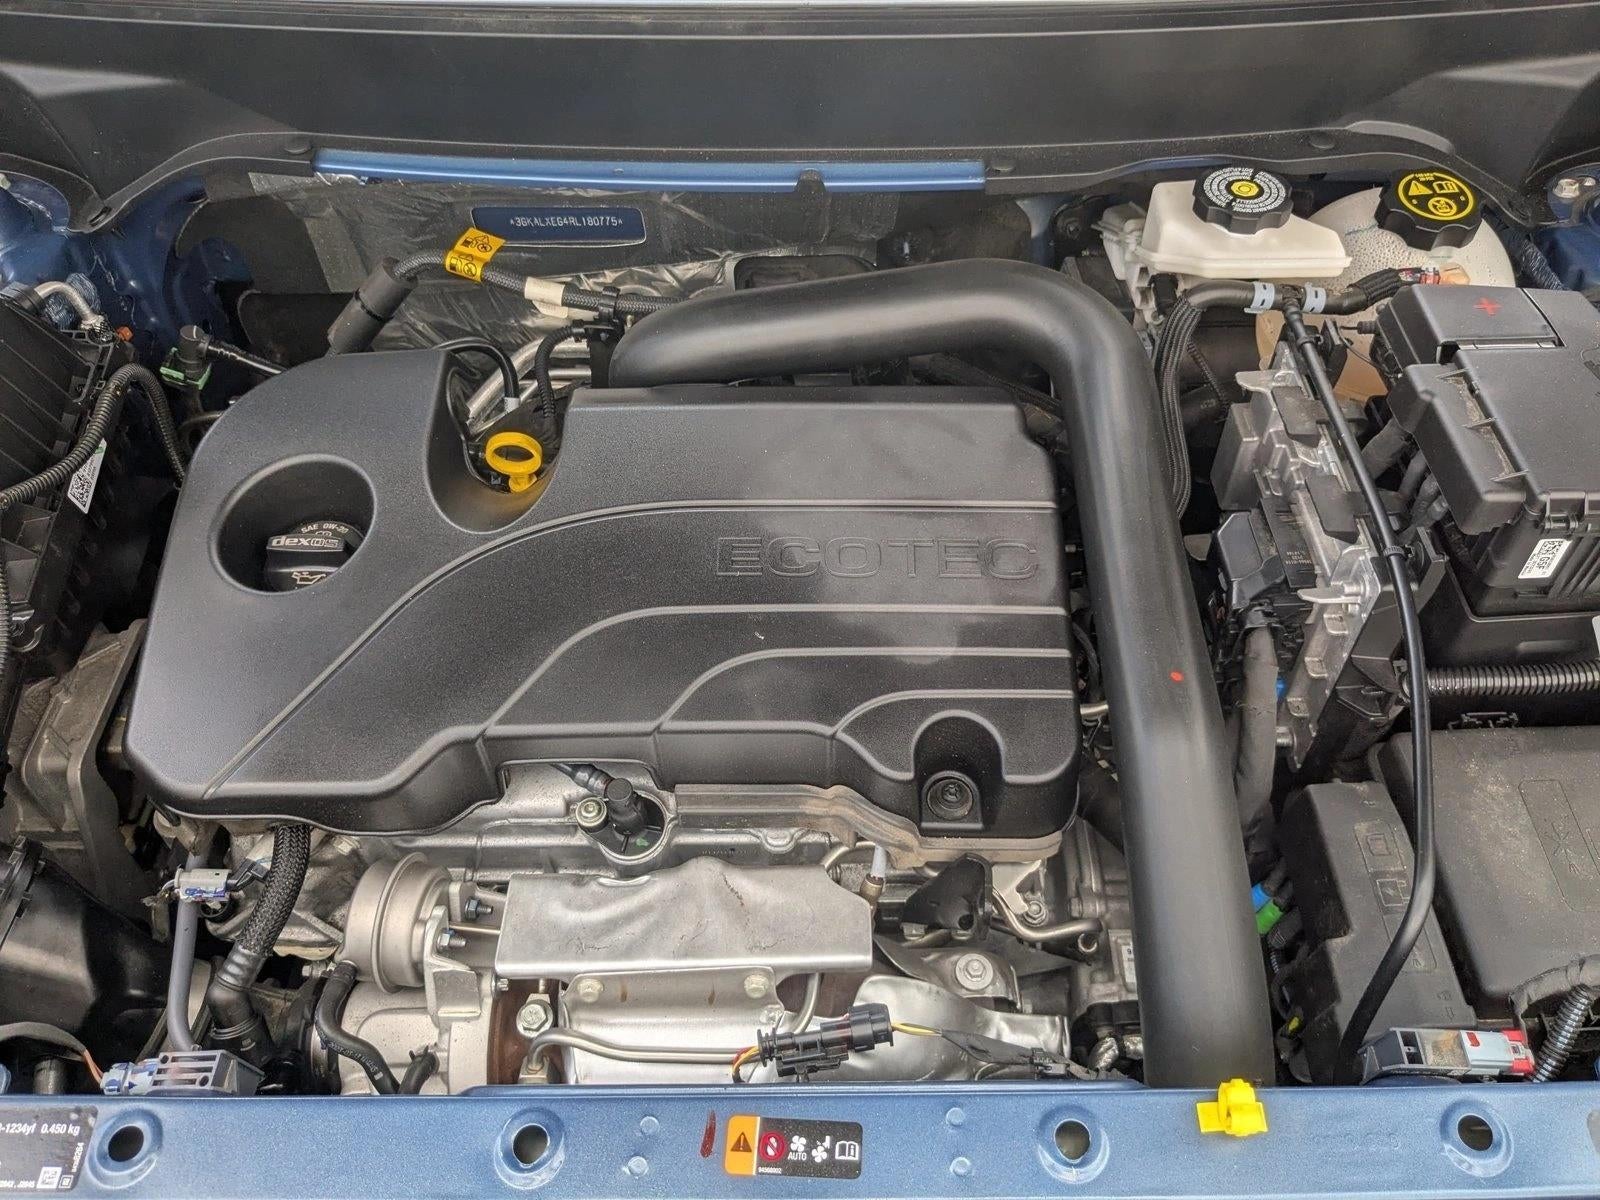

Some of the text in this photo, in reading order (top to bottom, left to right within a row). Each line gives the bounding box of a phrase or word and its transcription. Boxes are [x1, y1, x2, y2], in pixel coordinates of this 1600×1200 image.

[301, 523, 349, 534] SAE 0W-20
[271, 536, 339, 548] dexos
[716, 537, 1038, 580] ECOTEC
[0, 1122, 80, 1136] -1234yf 0.450 kg
[788, 1152, 807, 1161] AUTO
